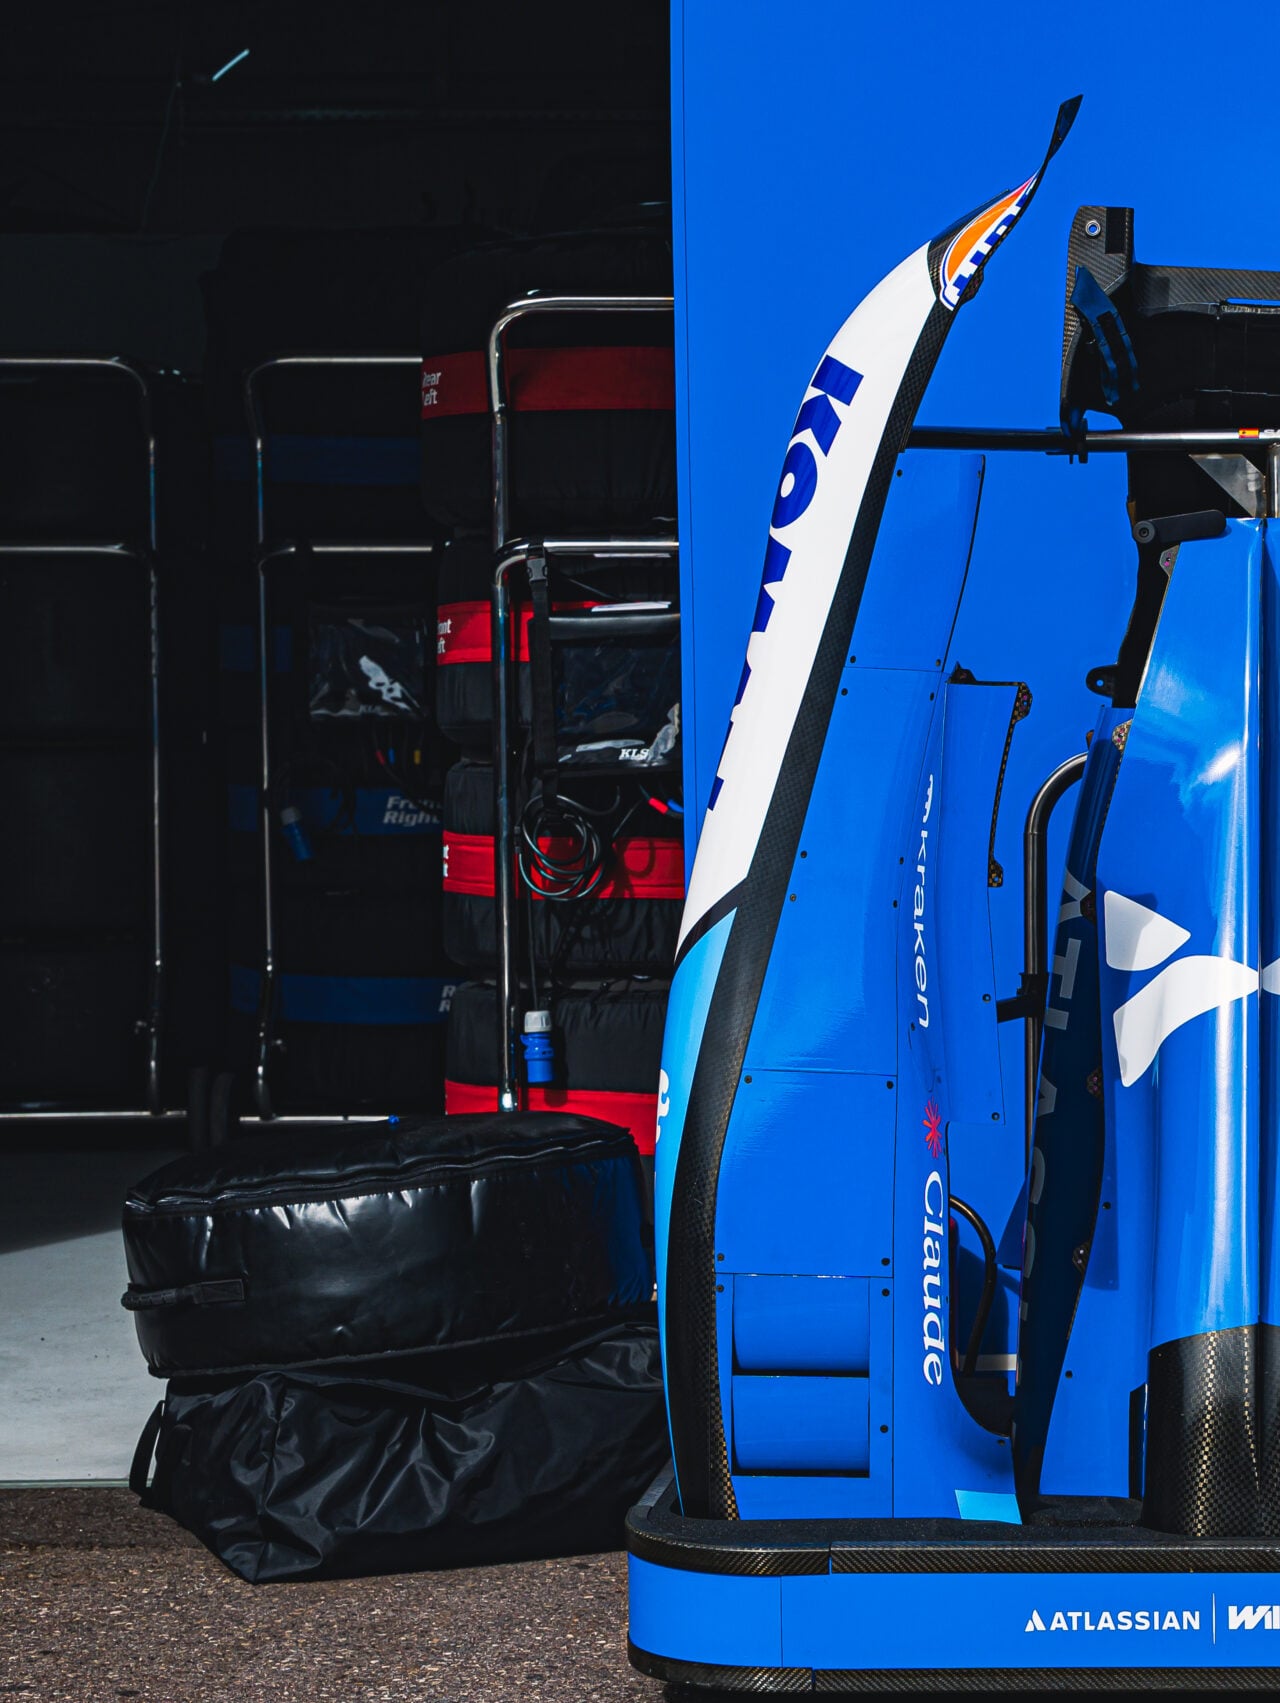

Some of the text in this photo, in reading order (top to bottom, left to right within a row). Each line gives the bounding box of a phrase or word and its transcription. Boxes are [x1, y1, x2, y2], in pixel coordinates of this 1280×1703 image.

[618, 748, 650, 761] KLS
[913, 830, 930, 1029] kraken
[922, 1170, 945, 1386] Claude
[1049, 1610, 1201, 1631] ATLASSIAN
